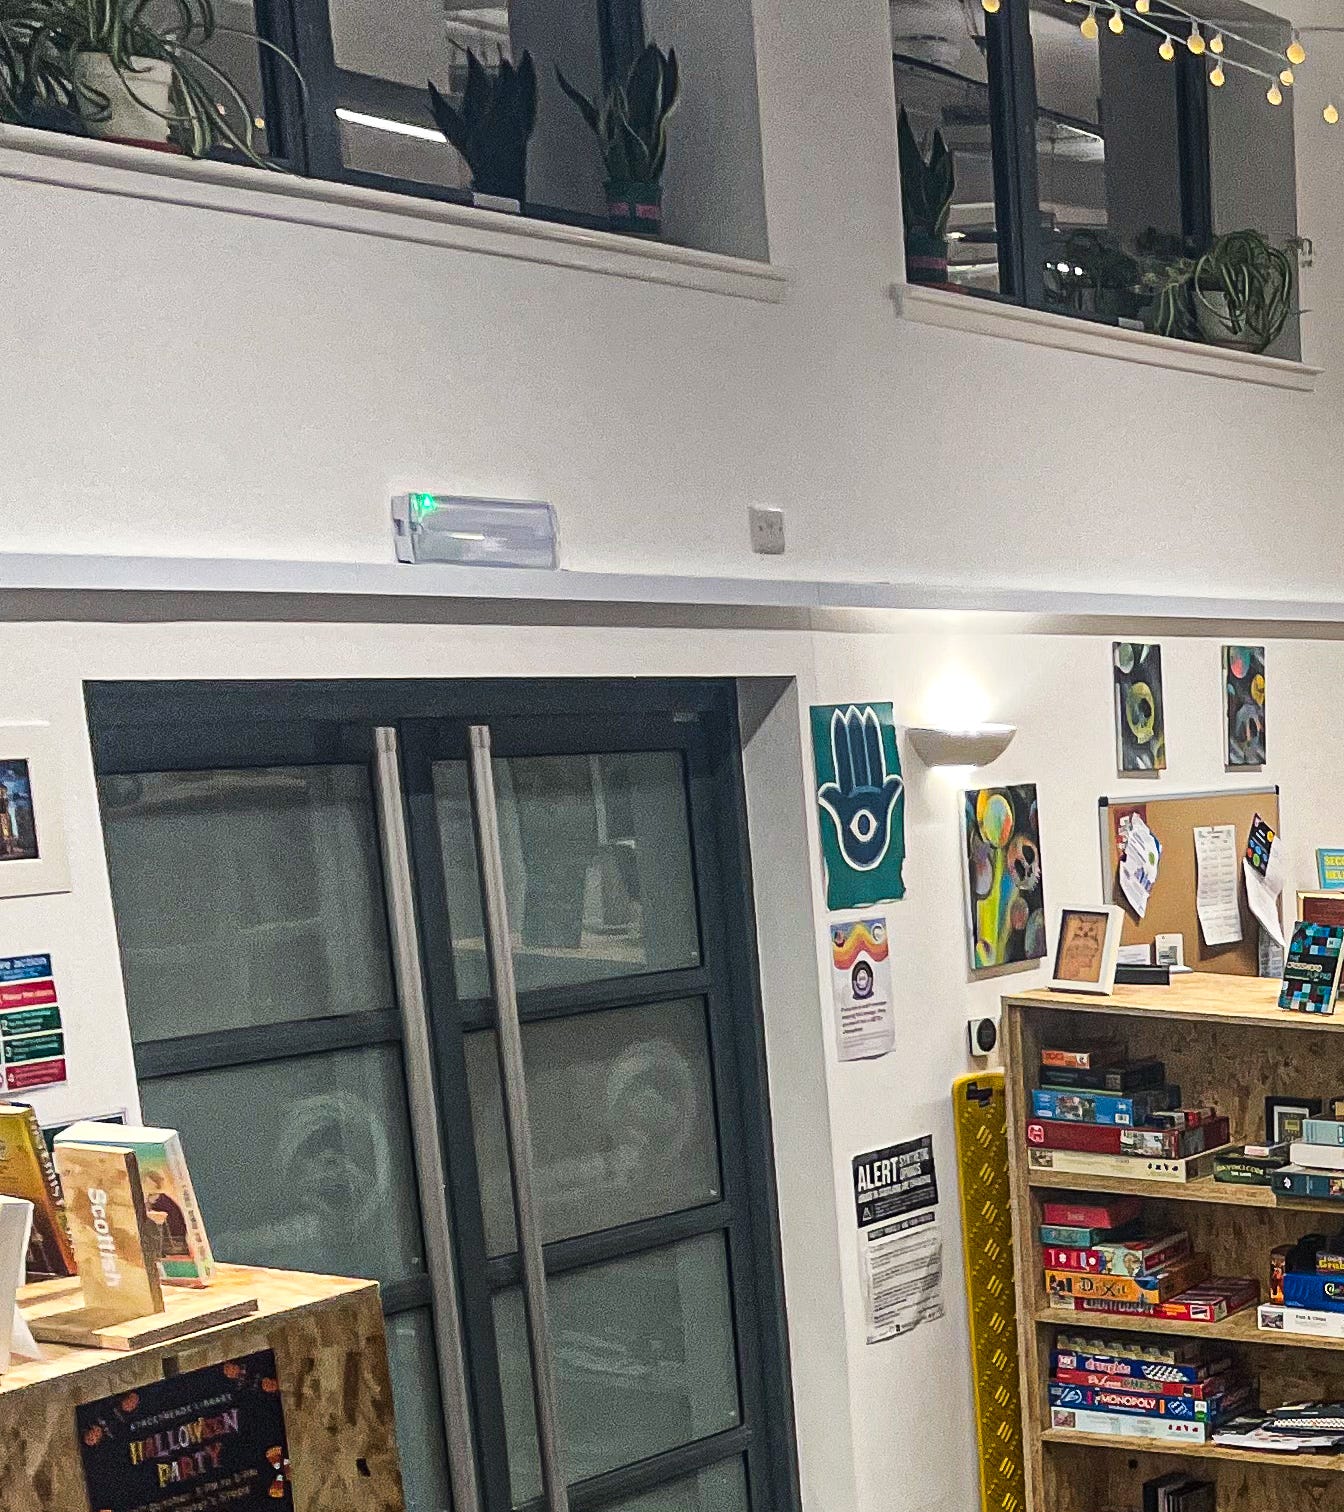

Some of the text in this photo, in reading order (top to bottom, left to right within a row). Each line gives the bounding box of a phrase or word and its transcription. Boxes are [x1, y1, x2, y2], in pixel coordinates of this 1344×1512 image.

[858, 1156, 899, 1192] ALERT
[87, 1187, 122, 1288] Scottish
[1100, 1393, 1156, 1409] MONOPOLY
[129, 1408, 239, 1465] HALLOWEEN
[157, 1442, 222, 1488] PARTY
